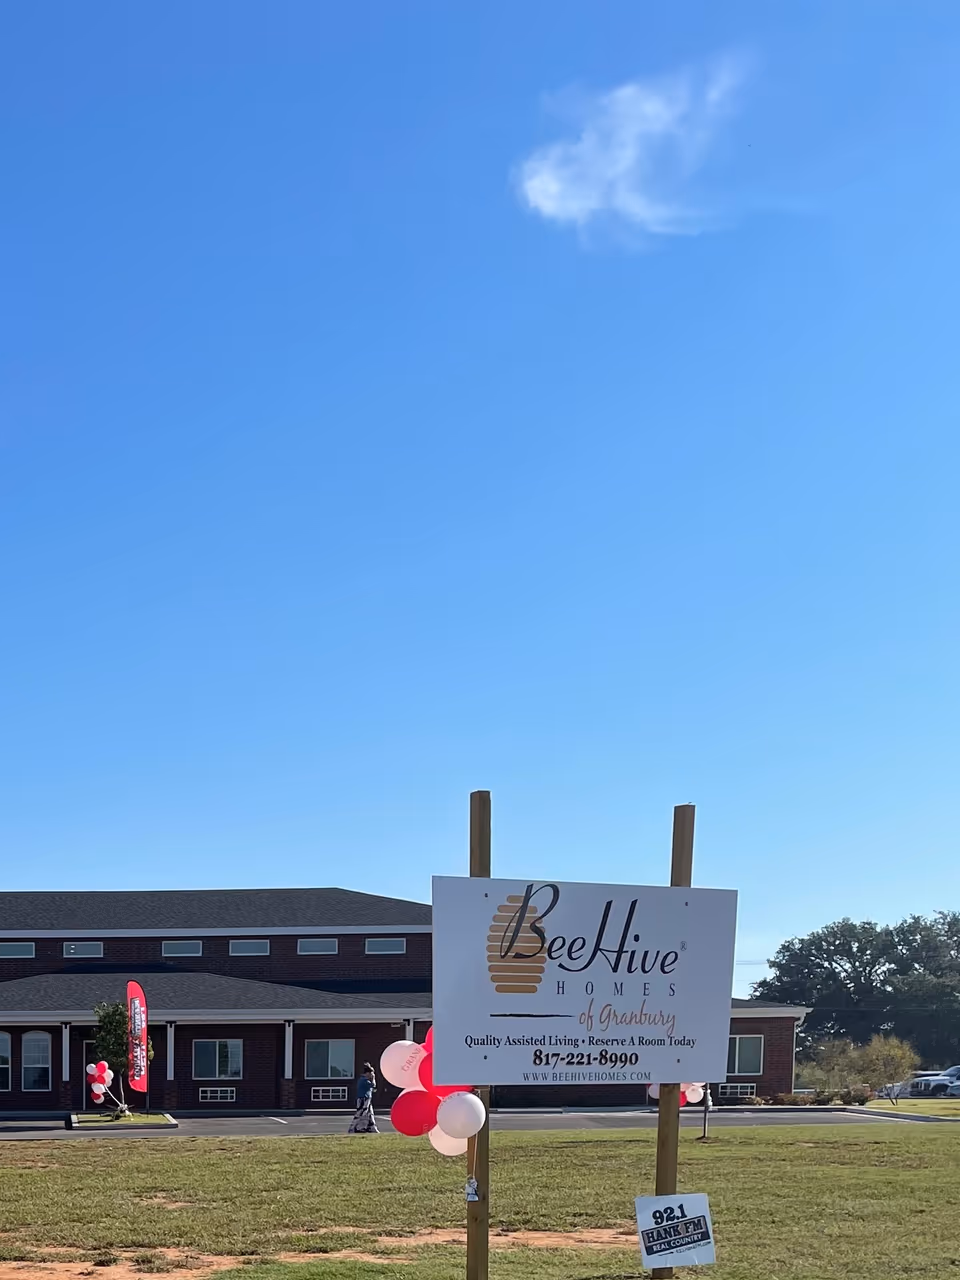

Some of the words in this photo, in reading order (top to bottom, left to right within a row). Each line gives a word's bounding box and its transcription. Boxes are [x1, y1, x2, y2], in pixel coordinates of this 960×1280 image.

[556, 980, 676, 997] HOMES
[578, 998, 594, 1031] of
[599, 999, 676, 1037] Granbury
[464, 1034, 502, 1048] Quality
[504, 1034, 546, 1046] Assisted
[548, 1034, 579, 1048] Living
[588, 1035, 627, 1047] Reserve
[628, 1036, 636, 1046] A
[638, 1036, 666, 1047] Room
[668, 1035, 697, 1048] Today
[533, 1048, 639, 1070] 817-221-8990
[652, 1203, 687, 1225] 92.1
[645, 1224, 682, 1244] HANK
[684, 1218, 703, 1234] FM
[652, 1243, 669, 1252] REAL
[671, 1233, 702, 1247] COUNTRY
